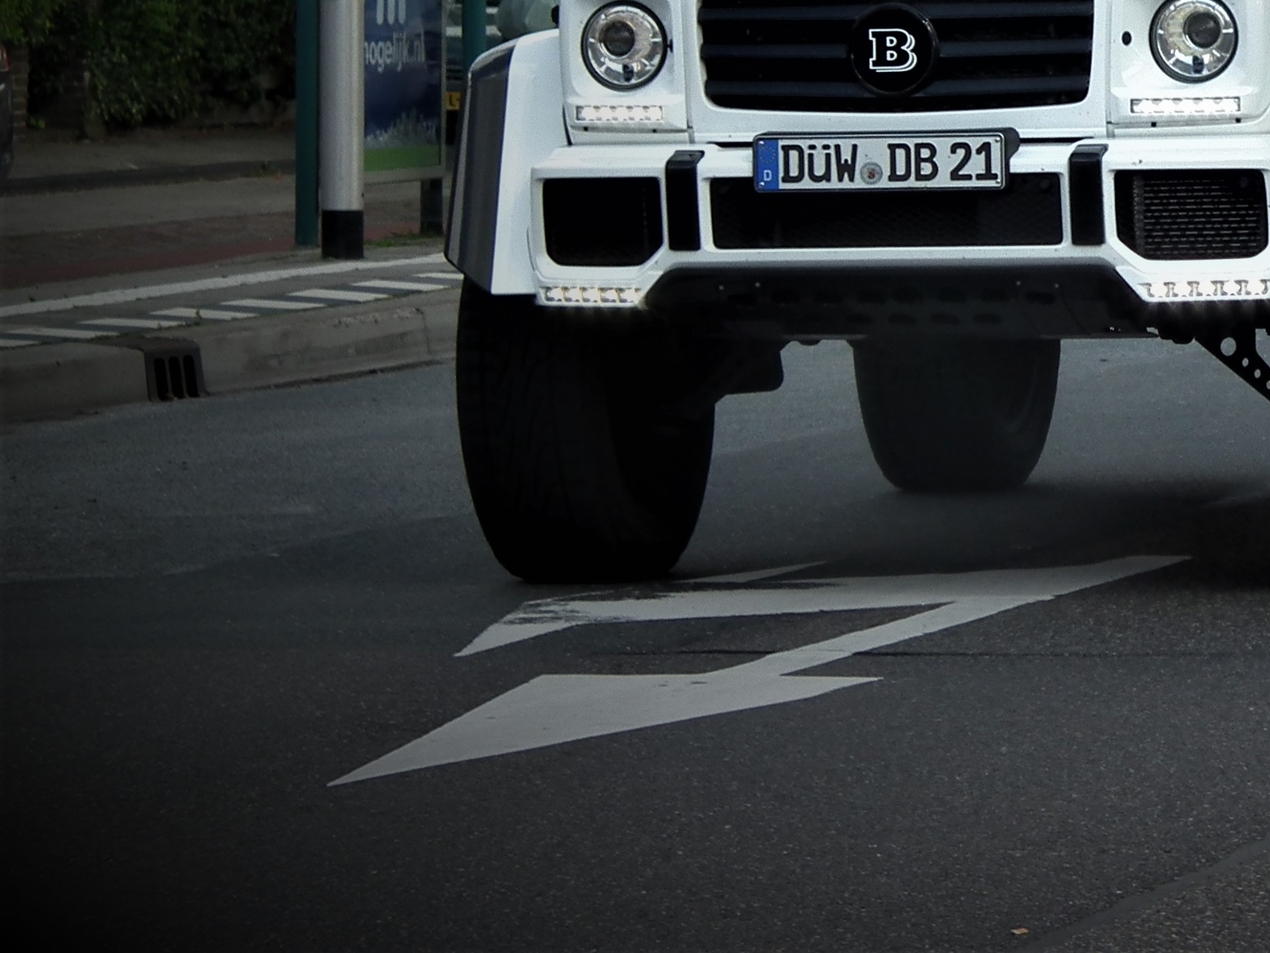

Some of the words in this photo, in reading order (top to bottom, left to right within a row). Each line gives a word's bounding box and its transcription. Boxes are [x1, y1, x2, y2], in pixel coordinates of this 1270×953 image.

[868, 28, 918, 73] B
[763, 169, 773, 182] D
[887, 141, 939, 182] DB
[948, 141, 999, 181] 21
